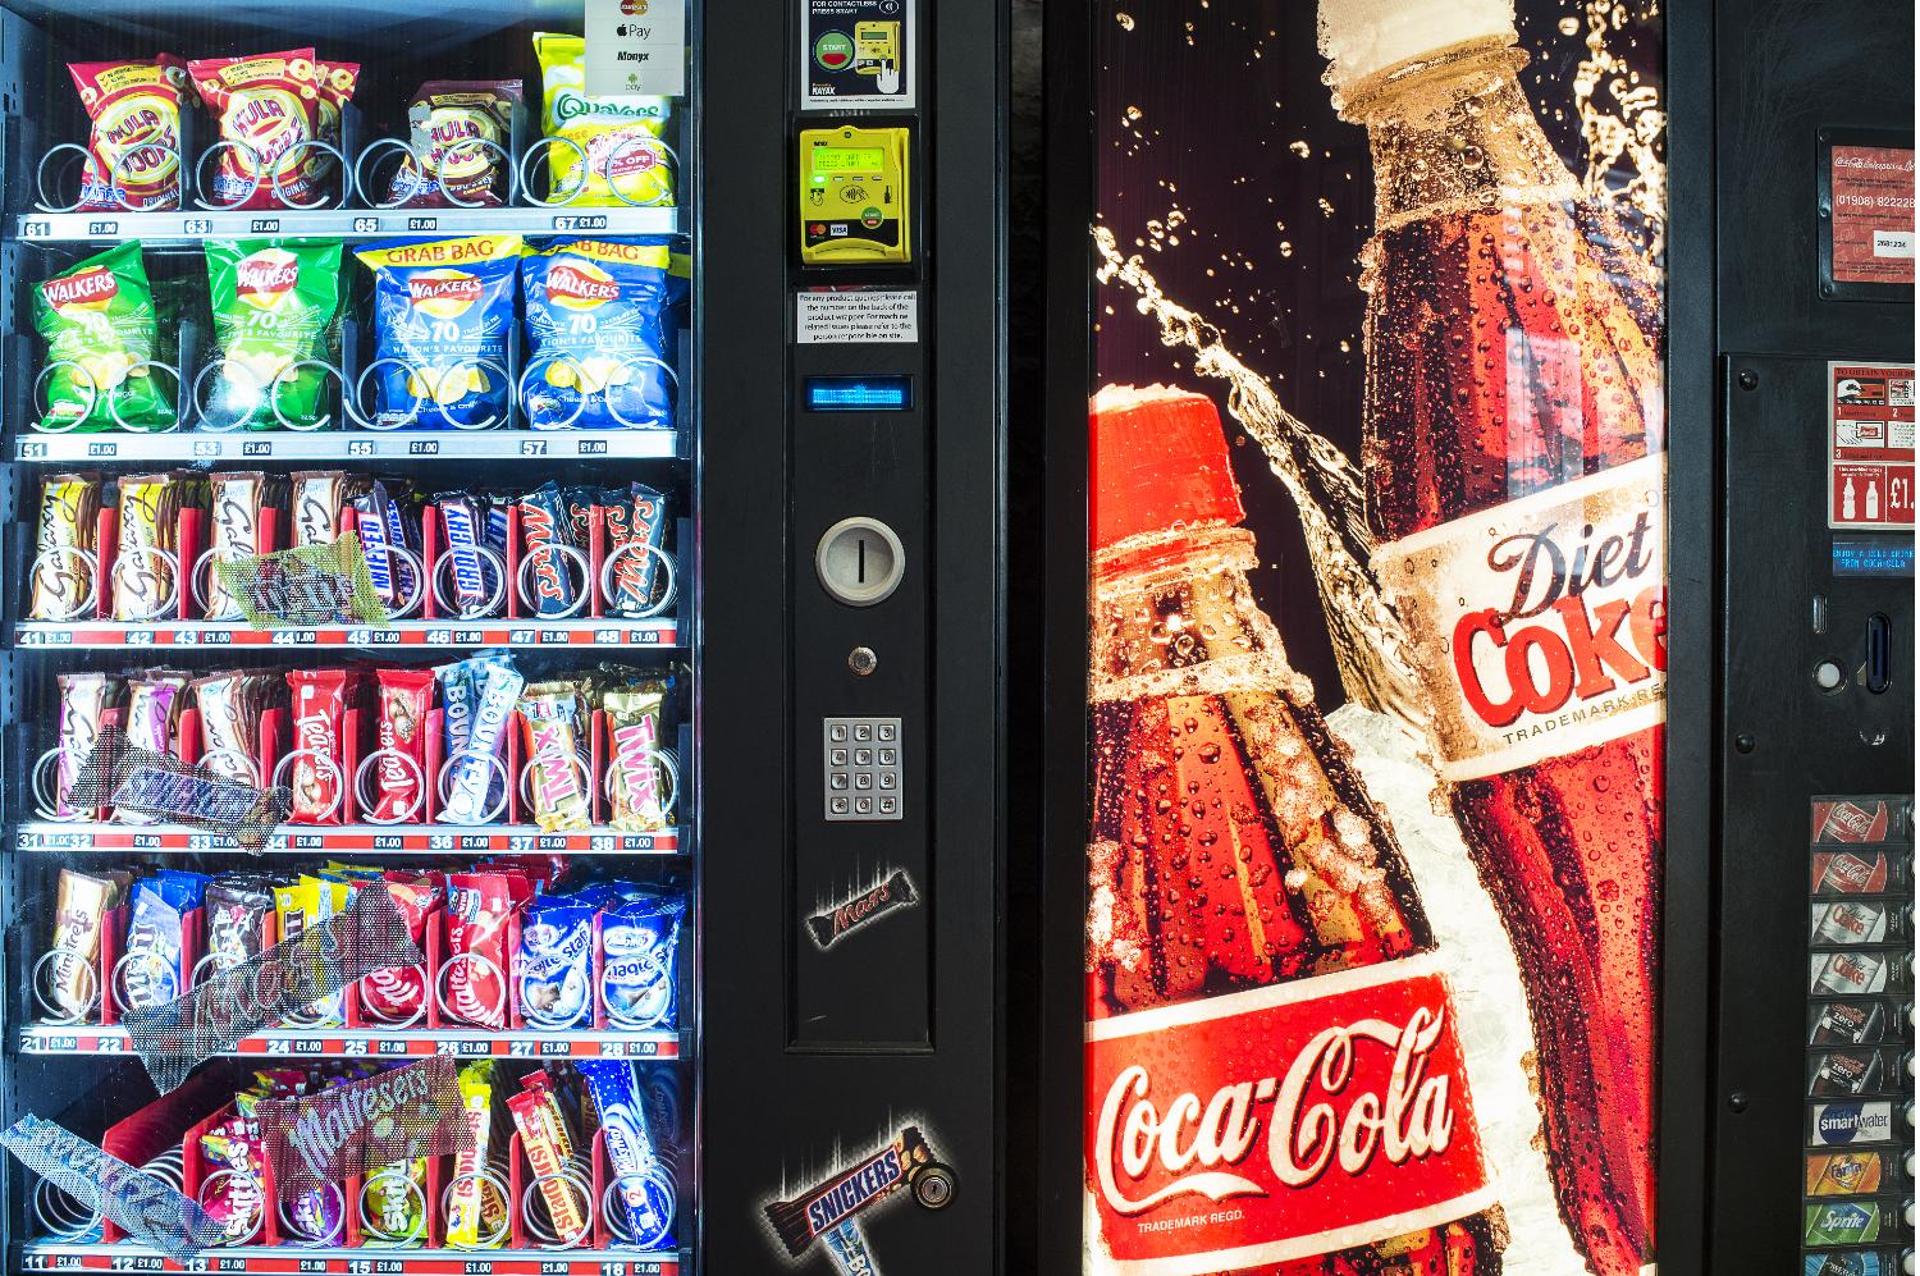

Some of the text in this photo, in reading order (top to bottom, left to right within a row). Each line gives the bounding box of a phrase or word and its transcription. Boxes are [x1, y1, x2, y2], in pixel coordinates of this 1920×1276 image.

[628, 25, 651, 40] Pay
[617, 51, 649, 63] Monyx
[91, 221, 117, 234] £1.00
[185, 219, 209, 233] 63
[252, 219, 279, 232] £1.00
[355, 218, 377, 233] 65
[409, 218, 436, 230] £1.00
[555, 216, 577, 230] 67
[579, 217, 606, 229] £1.00
[25, 223, 48, 237] 61
[386, 239, 495, 265] GRAB BAG
[597, 241, 640, 261] BAG
[236, 264, 298, 288] WALKERS
[43, 273, 116, 303] WALKERS
[407, 278, 483, 299] WALKERS
[545, 272, 620, 301] WALKERS
[568, 313, 597, 334] 70
[431, 321, 460, 342] 70
[1837, 406, 1842, 416] 1
[1892, 408, 1898, 418] 2
[22, 443, 43, 457] 51
[89, 444, 116, 456] £1.00
[244, 443, 271, 455] £1.00
[350, 442, 372, 455] 55
[410, 441, 438, 454] £1.00
[522, 441, 544, 455] 57
[579, 441, 606, 454] £1.00
[1835, 449, 1842, 459] 3
[517, 502, 564, 602] Mars
[619, 493, 655, 604] Mars
[1488, 512, 1655, 626] Diet
[20, 632, 43, 644] 41
[45, 632, 71, 643] £1.00
[128, 632, 151, 644] 42
[175, 632, 197, 644] 43
[204, 632, 231, 643] £1.00
[272, 632, 296, 644] 44
[348, 632, 370, 644] 45
[373, 632, 400, 643] £1.00
[427, 632, 449, 644] 46
[455, 632, 482, 643] £1.00
[511, 631, 532, 643] 47
[542, 631, 568, 643] £1.00
[597, 631, 620, 643] 48
[631, 631, 658, 642] £1.00
[1453, 592, 1668, 728] Coke
[447, 685, 471, 757] BOUN
[1503, 696, 1630, 746] TRADEMARK
[299, 707, 333, 782] Teasers
[533, 724, 575, 813] Twix
[613, 713, 661, 816] Twix
[19, 836, 37, 848] 31
[69, 836, 91, 848] 32
[134, 836, 161, 847] £1.00
[189, 836, 211, 848] 33
[296, 836, 322, 847] £1.00
[375, 836, 401, 847] £1.00
[430, 838, 453, 849] 36
[461, 837, 488, 848] £1.00
[511, 838, 532, 850] 37
[539, 837, 566, 848] £1.00
[592, 838, 615, 850] 38
[624, 837, 651, 848] £1.00
[832, 882, 891, 935] Mars
[55, 909, 93, 994] Minstrels
[1833, 1011, 1856, 1028] zero
[22, 1038, 41, 1050] 21
[50, 1038, 76, 1049] £1.00
[99, 1038, 121, 1051] 22
[268, 1040, 291, 1053] 24
[296, 1041, 322, 1051] £1.00
[345, 1041, 368, 1053] 25
[379, 1041, 406, 1052] £1.00
[438, 1041, 460, 1054] 26
[462, 1041, 489, 1052] £1.00
[510, 1042, 532, 1055] 27
[542, 1042, 569, 1052] £1.00
[602, 1042, 625, 1055] 28
[629, 1042, 656, 1052] £1.00
[1831, 1062, 1854, 1079] zero
[1096, 1003, 1455, 1214] Coca-Cola
[1820, 1112, 1889, 1133] smartwater
[807, 1150, 902, 1233] SNICKERS
[1137, 1209, 1246, 1234] TRADEMARK REGD.
[1820, 1211, 1865, 1232] Sprite
[25, 1257, 45, 1268] 11
[56, 1256, 82, 1267] £1.00
[113, 1258, 134, 1271] 12
[137, 1258, 163, 1268] £1.00
[186, 1260, 207, 1272] 13
[219, 1259, 245, 1270] £1.00
[300, 1260, 326, 1271] £1.00
[350, 1261, 371, 1274] 15
[376, 1261, 403, 1272] £1.00
[465, 1262, 492, 1273] £1.00
[542, 1262, 568, 1274] £1.00
[603, 1264, 624, 1276] 18
[634, 1263, 660, 1274] £1.00
